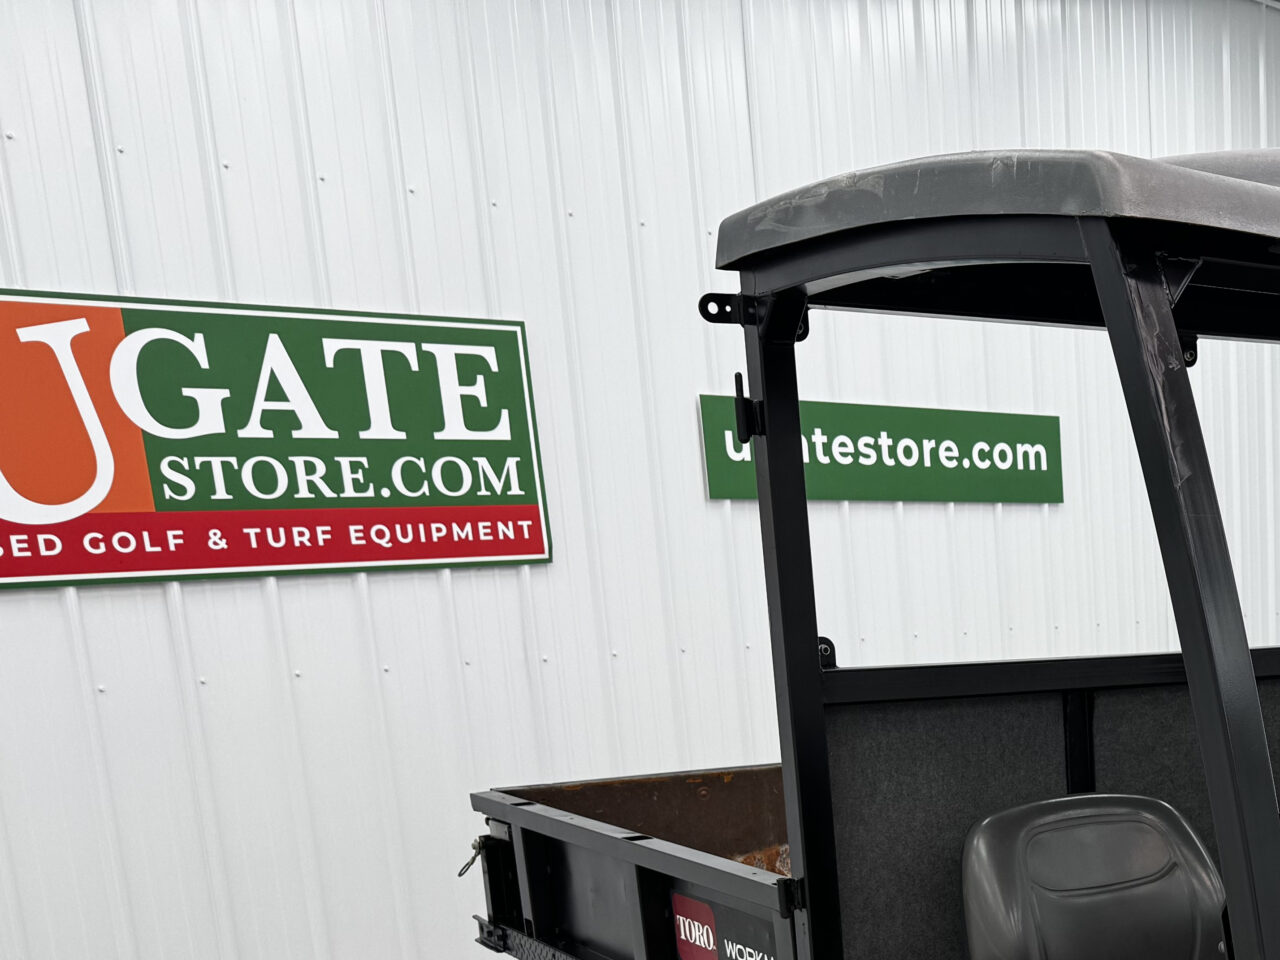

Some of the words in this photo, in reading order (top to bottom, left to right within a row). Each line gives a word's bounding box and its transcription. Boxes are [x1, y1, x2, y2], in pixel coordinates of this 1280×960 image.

[724, 428, 1047, 471] utestore.com
[159, 455, 525, 500] STORE.COM
[0, 533, 63, 557] ED
[83, 529, 185, 555] GOLF
[207, 528, 228, 549] &
[243, 526, 333, 549] TURF
[349, 520, 533, 545] EQUIPMENT
[676, 914, 715, 950] TORO
